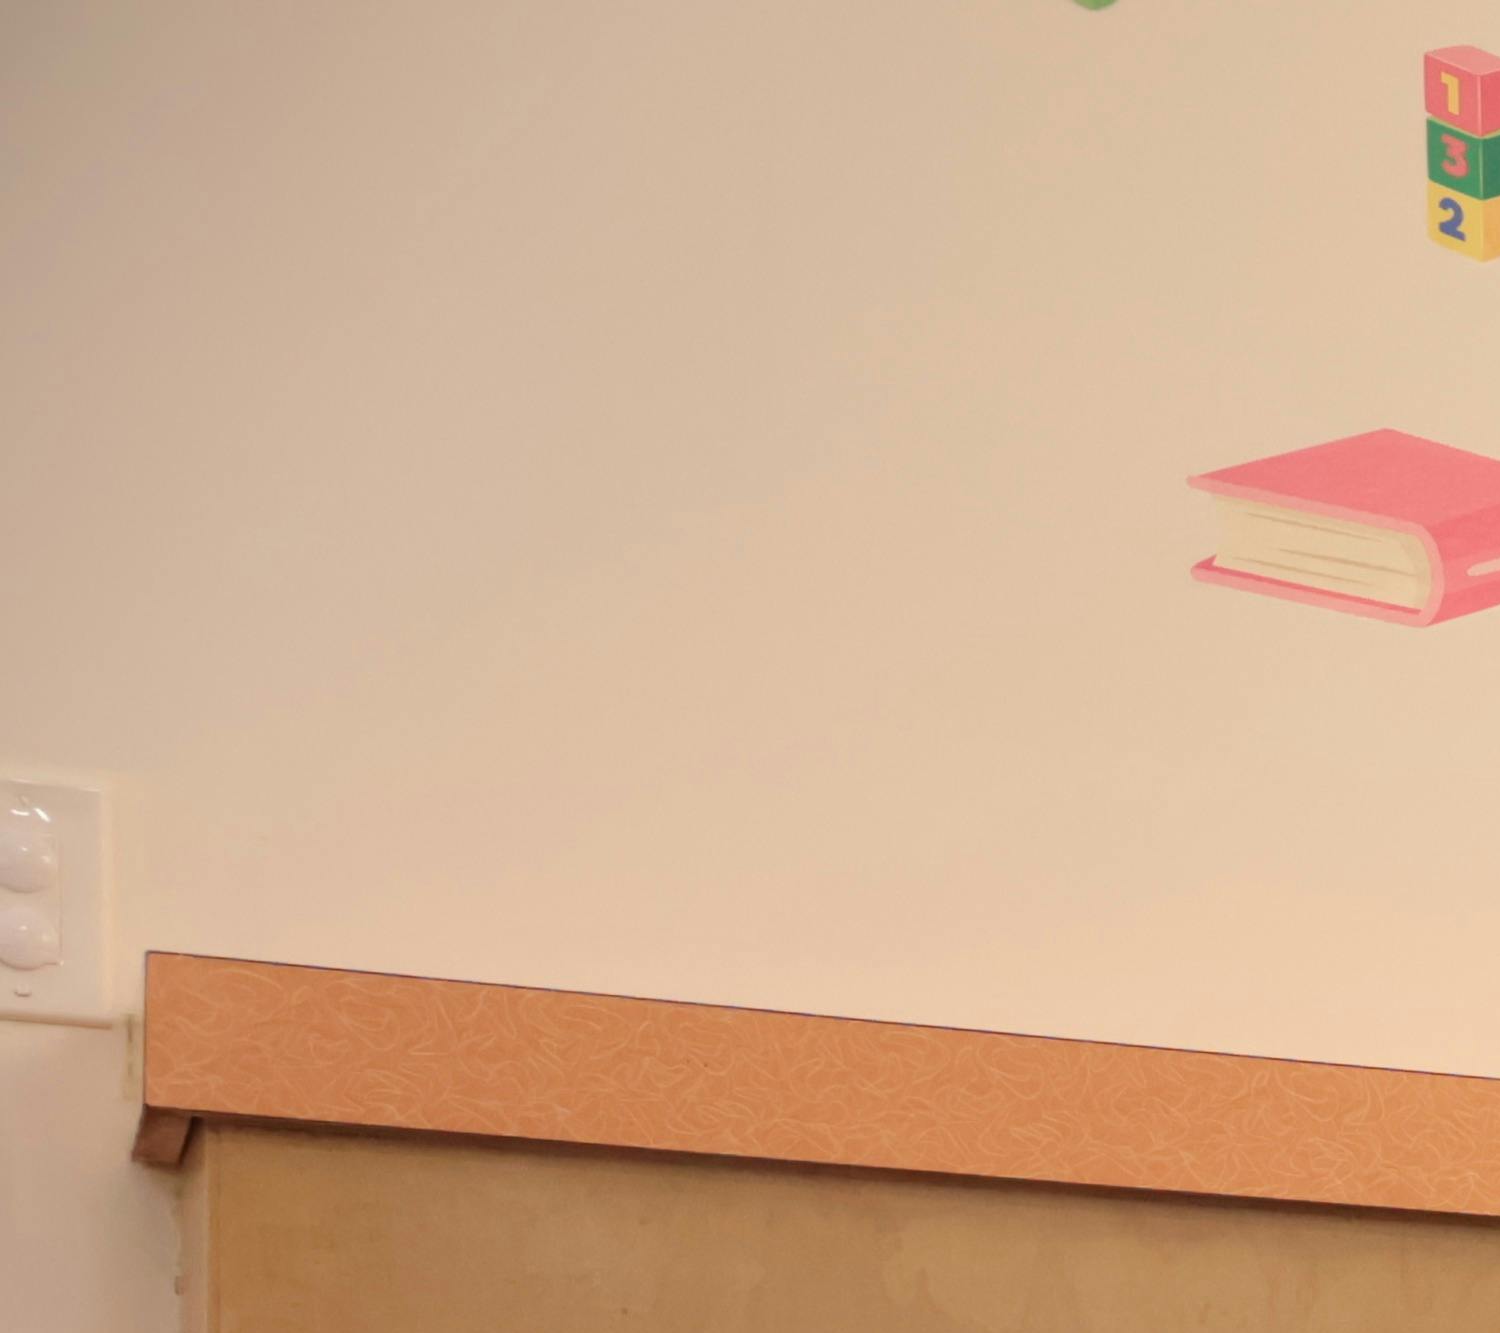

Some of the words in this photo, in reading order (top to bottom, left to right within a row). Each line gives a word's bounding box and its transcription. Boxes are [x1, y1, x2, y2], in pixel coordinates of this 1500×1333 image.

[1441, 71, 1460, 115] 1
[1440, 133, 1469, 178] 3
[1438, 197, 1466, 241] 2
